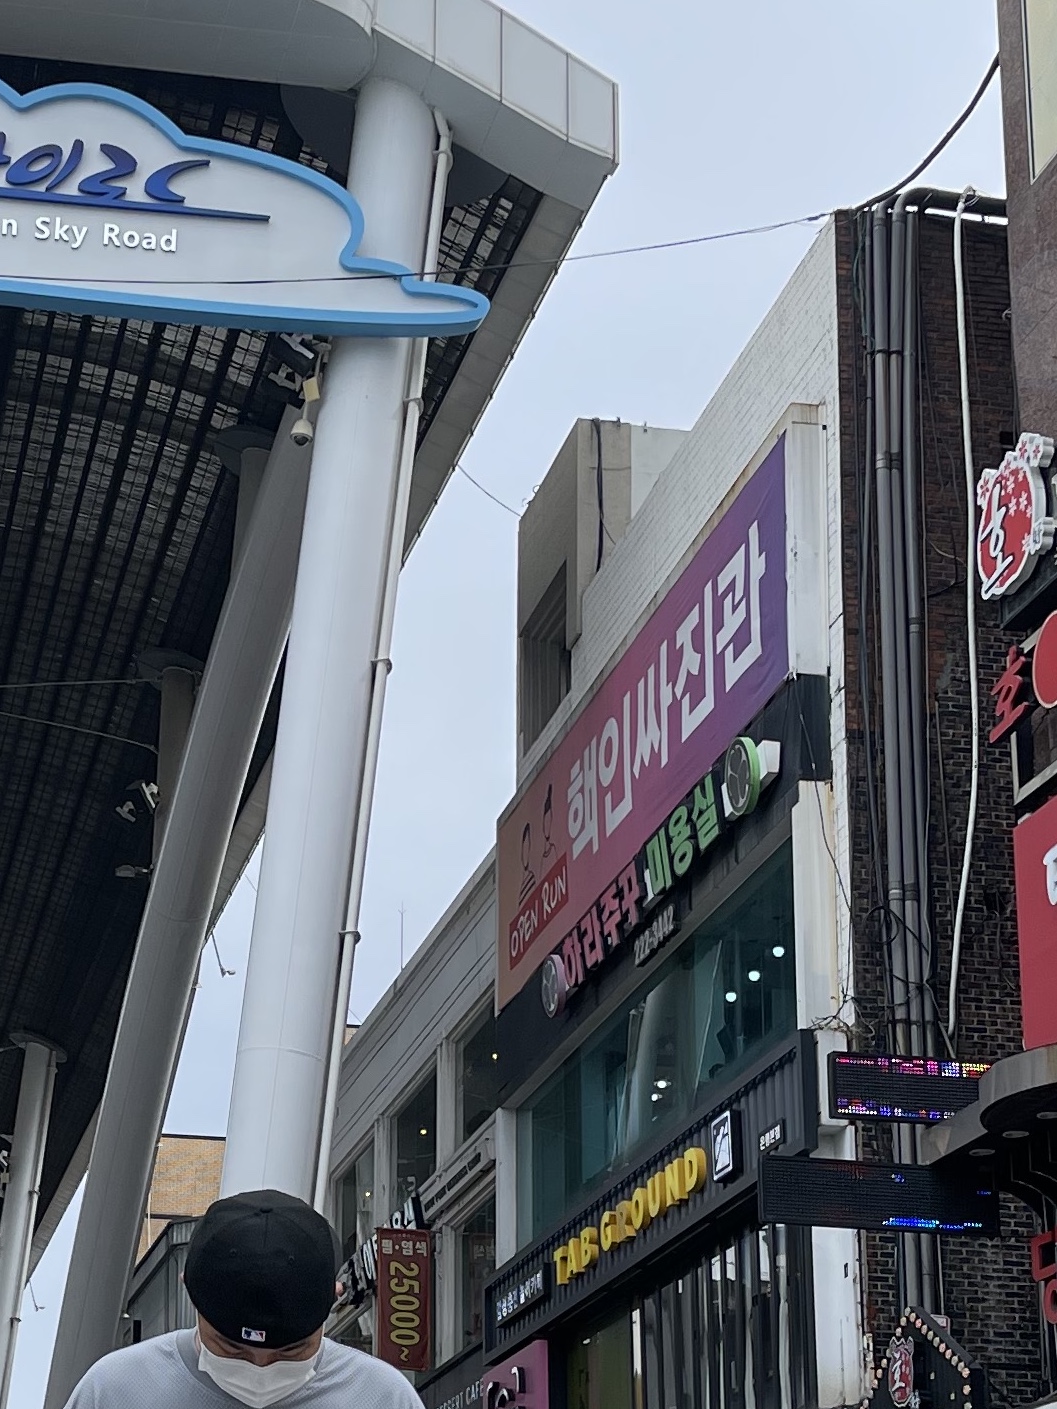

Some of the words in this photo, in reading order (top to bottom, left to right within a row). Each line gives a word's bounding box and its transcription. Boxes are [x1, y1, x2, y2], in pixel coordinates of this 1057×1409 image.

[34, 215, 88, 249] Sky
[101, 222, 179, 253] Road
[567, 521, 766, 860] 핵인싸진관
[511, 899, 539, 957] OPEN
[543, 866, 566, 914] RUN
[562, 860, 642, 988] 하라주쿠
[646, 772, 722, 895] 미용실
[634, 905, 677, 967] 222-3442
[553, 1233, 598, 1287] TAB
[600, 1147, 707, 1253] GROUND
[466, 1378, 485, 1405] CAFE
